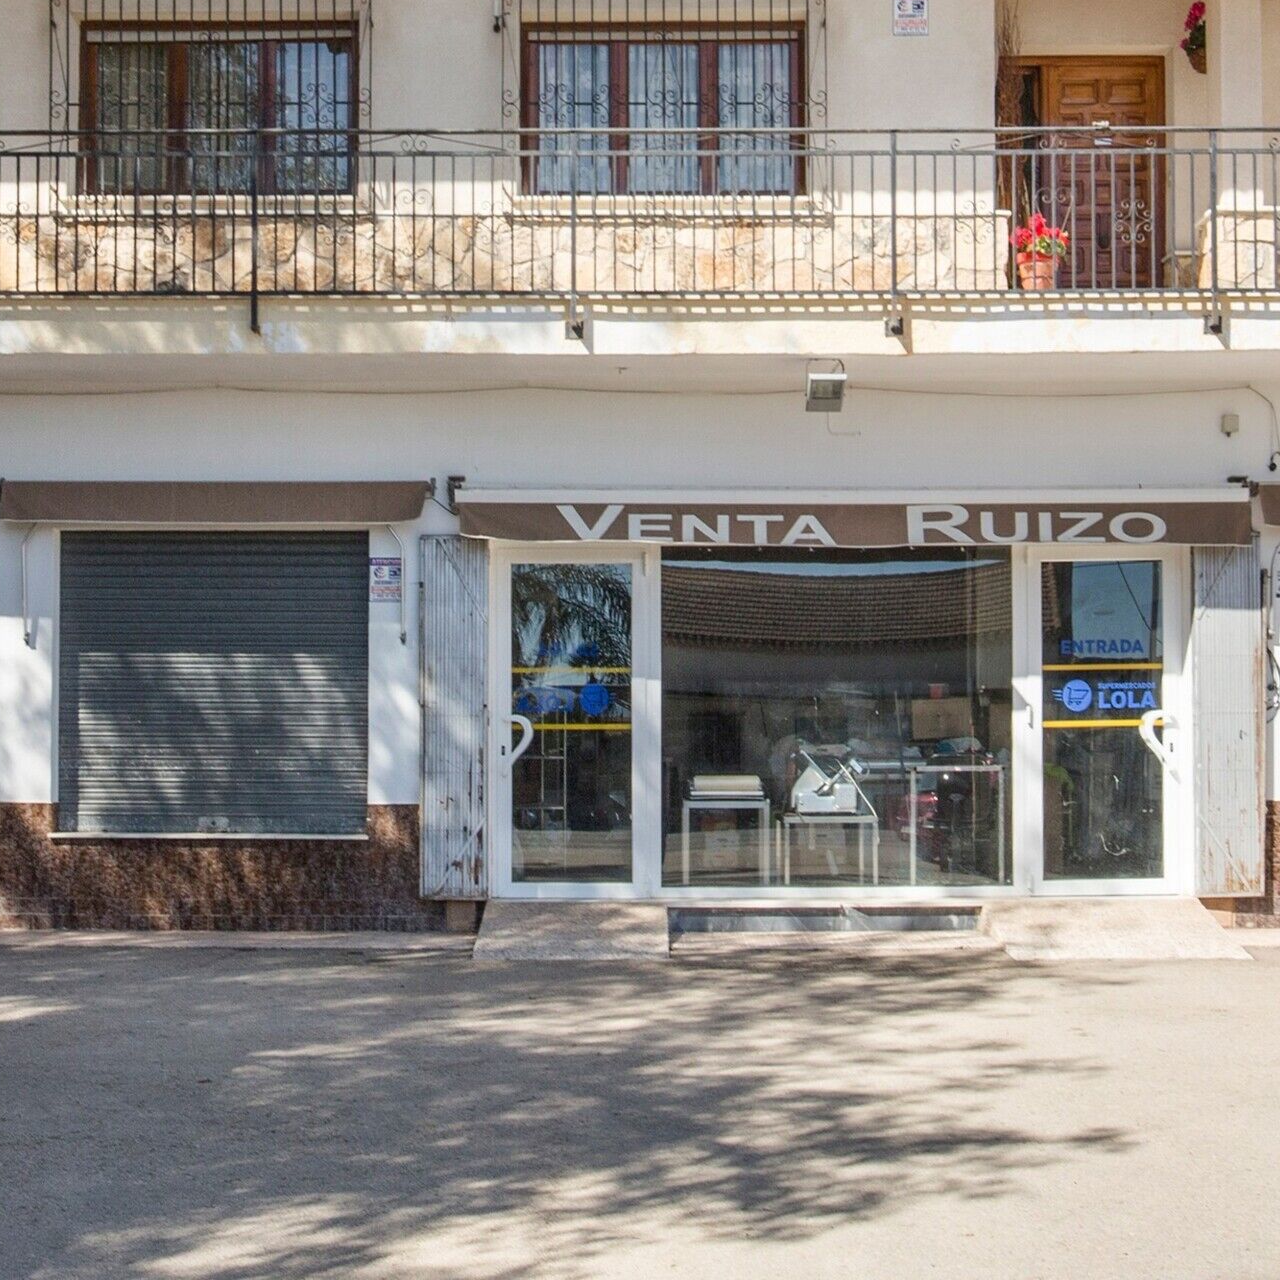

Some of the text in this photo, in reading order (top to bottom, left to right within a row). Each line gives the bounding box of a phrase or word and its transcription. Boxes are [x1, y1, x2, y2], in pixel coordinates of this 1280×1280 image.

[556, 504, 1167, 545] VENTA RUIZO
[1060, 639, 1144, 655] ENTRADA
[1098, 691, 1157, 709] LOLA
